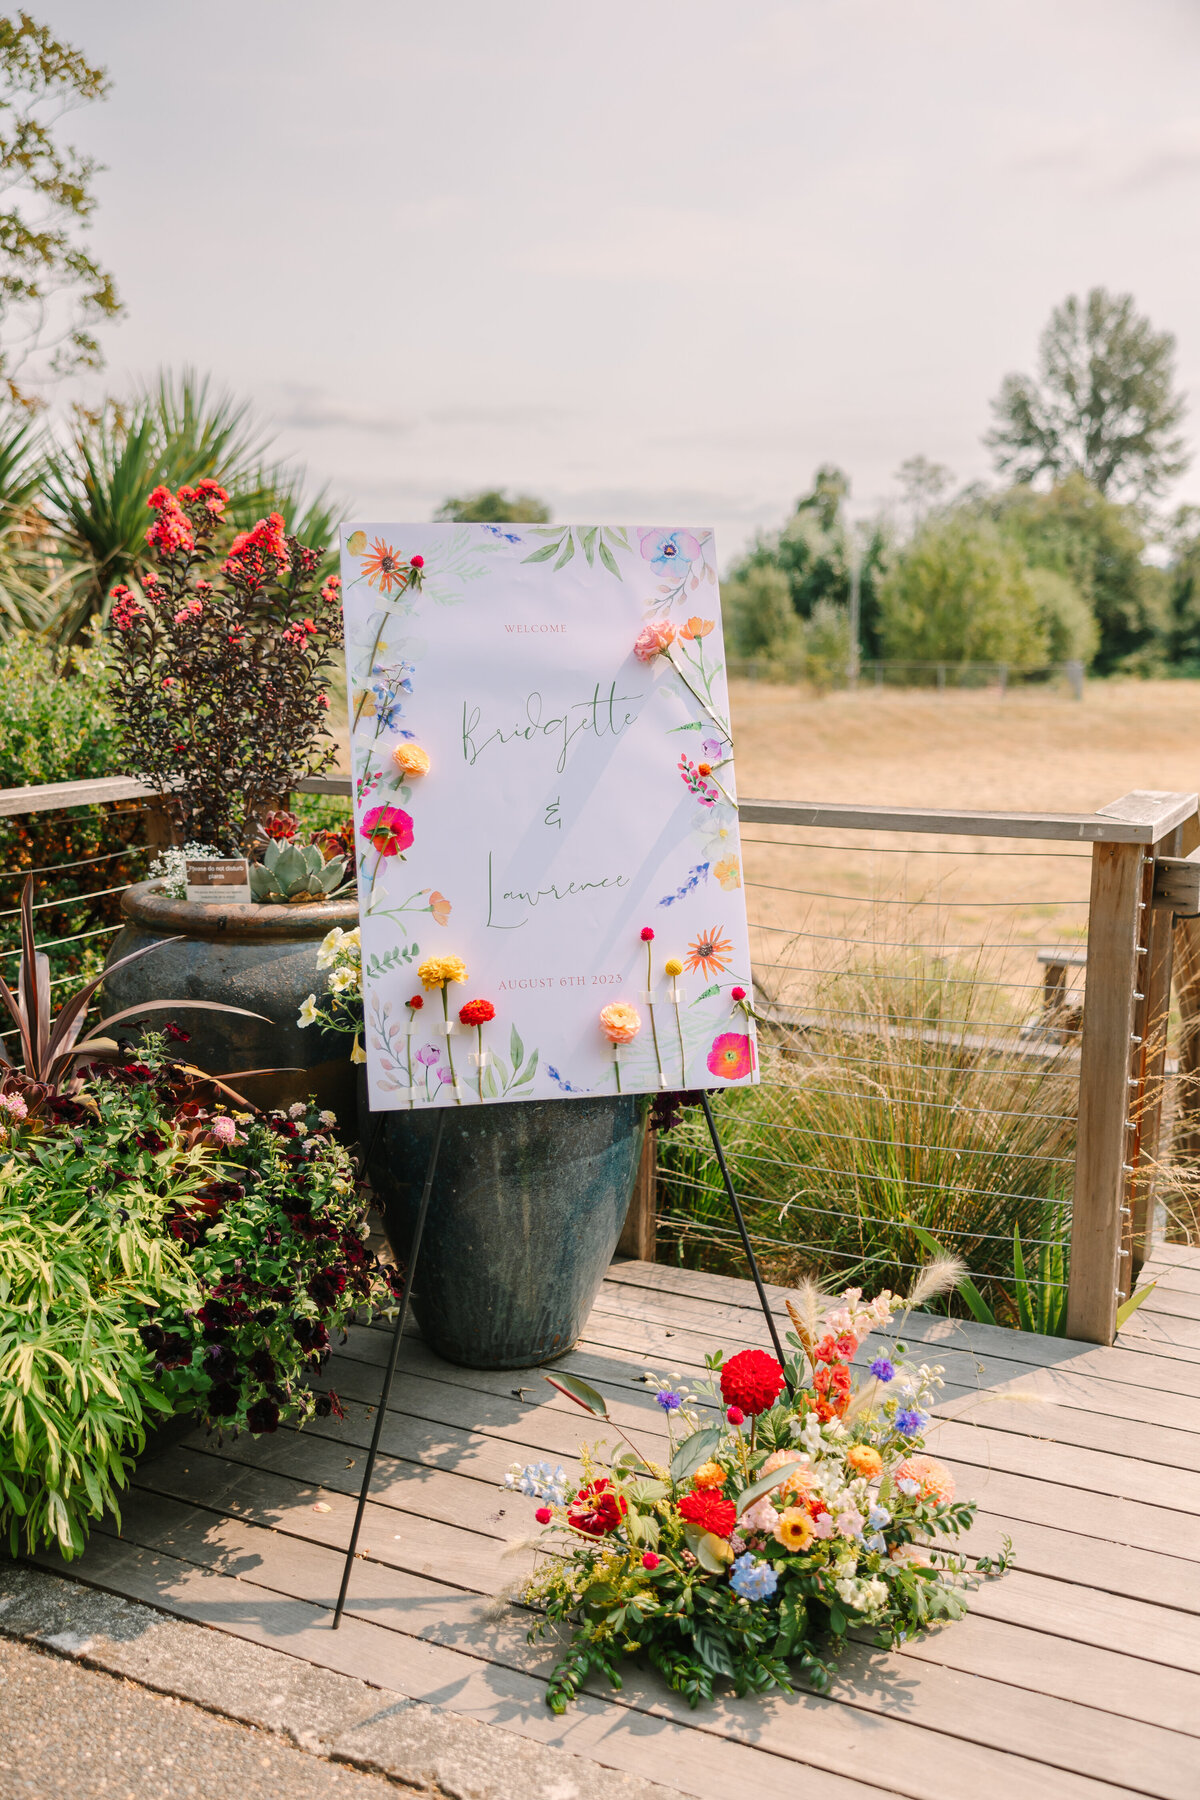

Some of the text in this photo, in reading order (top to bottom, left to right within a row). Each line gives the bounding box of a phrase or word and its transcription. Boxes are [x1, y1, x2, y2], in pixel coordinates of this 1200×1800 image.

[504, 624, 568, 634] WELCOME
[462, 681, 643, 774] Bridgette
[544, 796, 562, 829] &
[486, 851, 630, 929] Lawrence
[498, 974, 623, 991] AUGUST 6TH 2023
